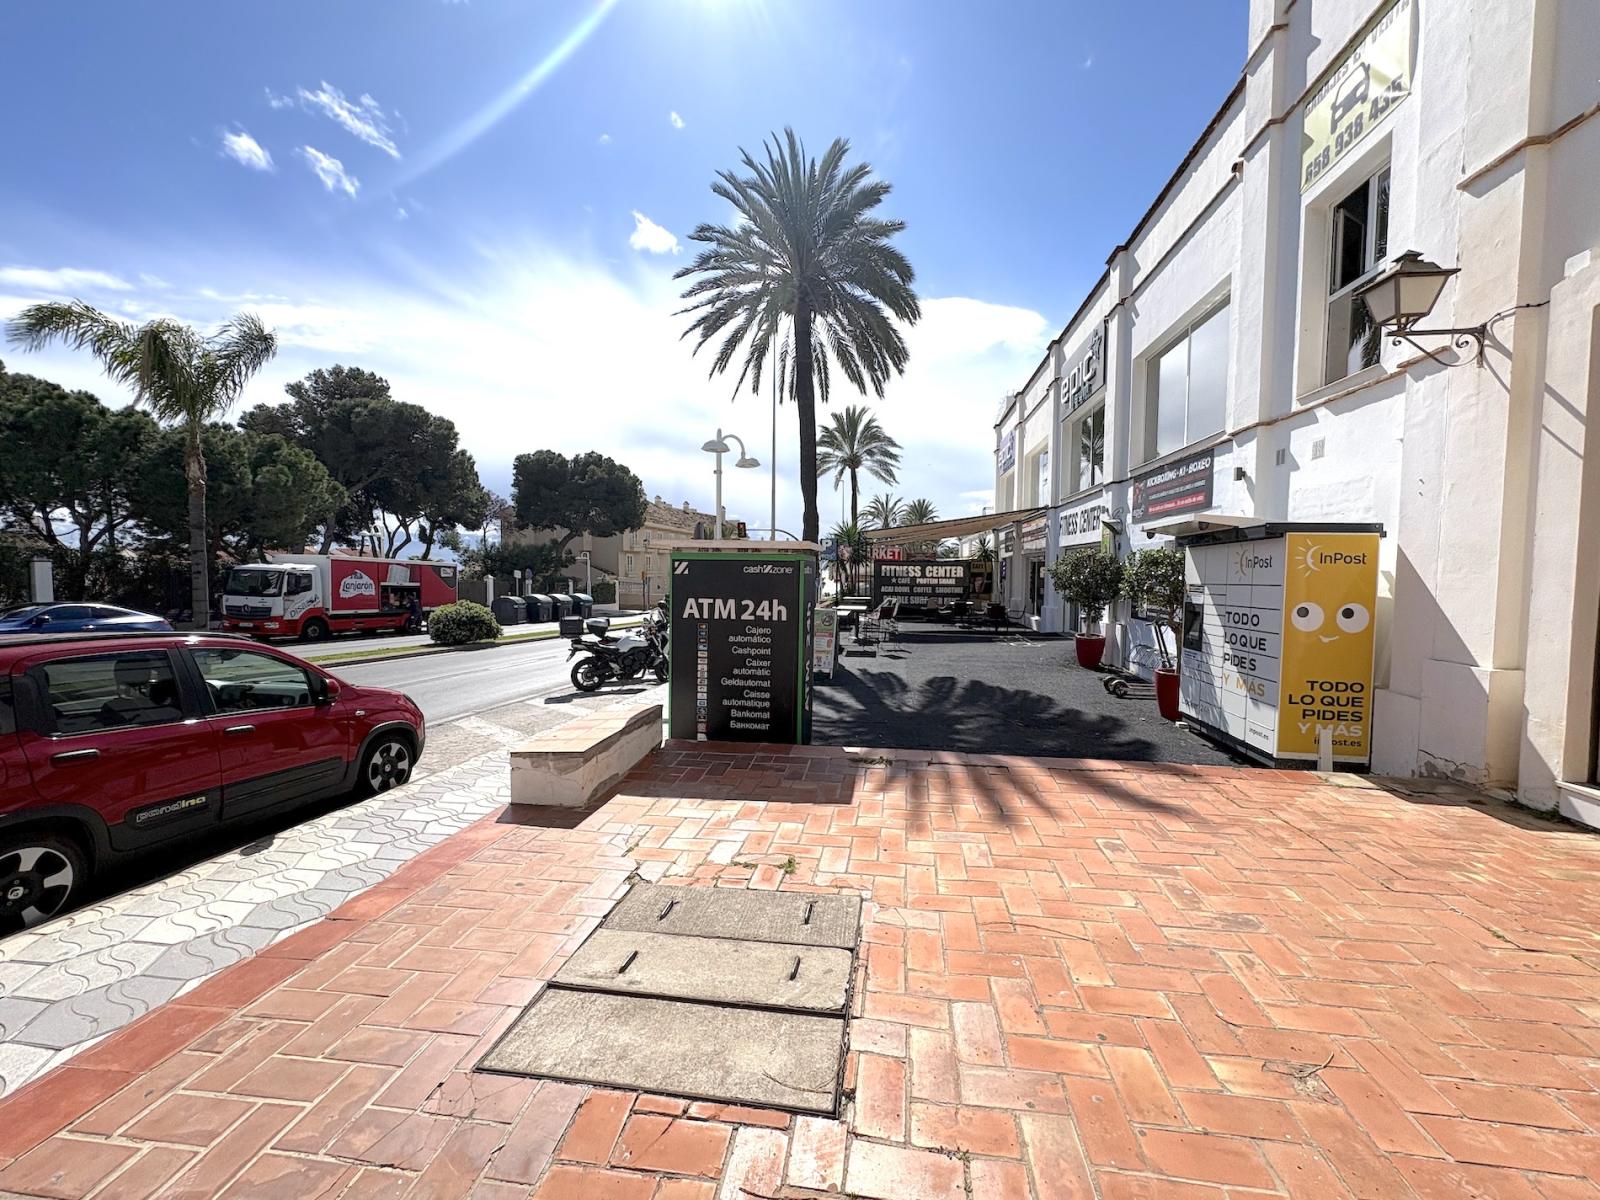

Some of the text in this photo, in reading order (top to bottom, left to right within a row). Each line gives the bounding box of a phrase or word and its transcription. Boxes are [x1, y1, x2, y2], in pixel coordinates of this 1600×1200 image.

[1335, 112, 1363, 157] 938
[1061, 350, 1096, 409] epic
[1246, 555, 1273, 569] InPost
[1320, 552, 1367, 565] InPost
[881, 565, 964, 578] FITNESS CENTER
[343, 581, 373, 593] Lanjarón
[682, 598, 788, 621] ATM 24h
[1226, 611, 1260, 627] TODO
[745, 625, 772, 635] Cajero
[728, 635, 772, 643] automático
[1225, 632, 1267, 652] LO QUE
[731, 646, 771, 656] Cashpoint
[745, 658, 771, 667] Caixer
[1224, 652, 1257, 672] PIDES
[720, 677, 771, 688] Geldautomat
[1223, 672, 1265, 697] Y MÁS
[1306, 680, 1365, 693] TODO
[743, 690, 771, 699] Caisse
[1288, 694, 1364, 708] LO QUE
[722, 699, 770, 709] automatique
[731, 709, 770, 719] Bankomat
[1302, 708, 1363, 722] PIDES
[730, 720, 770, 730] Банкомат
[1297, 721, 1362, 736] Y MÁS
[1314, 737, 1361, 747] iost.es
